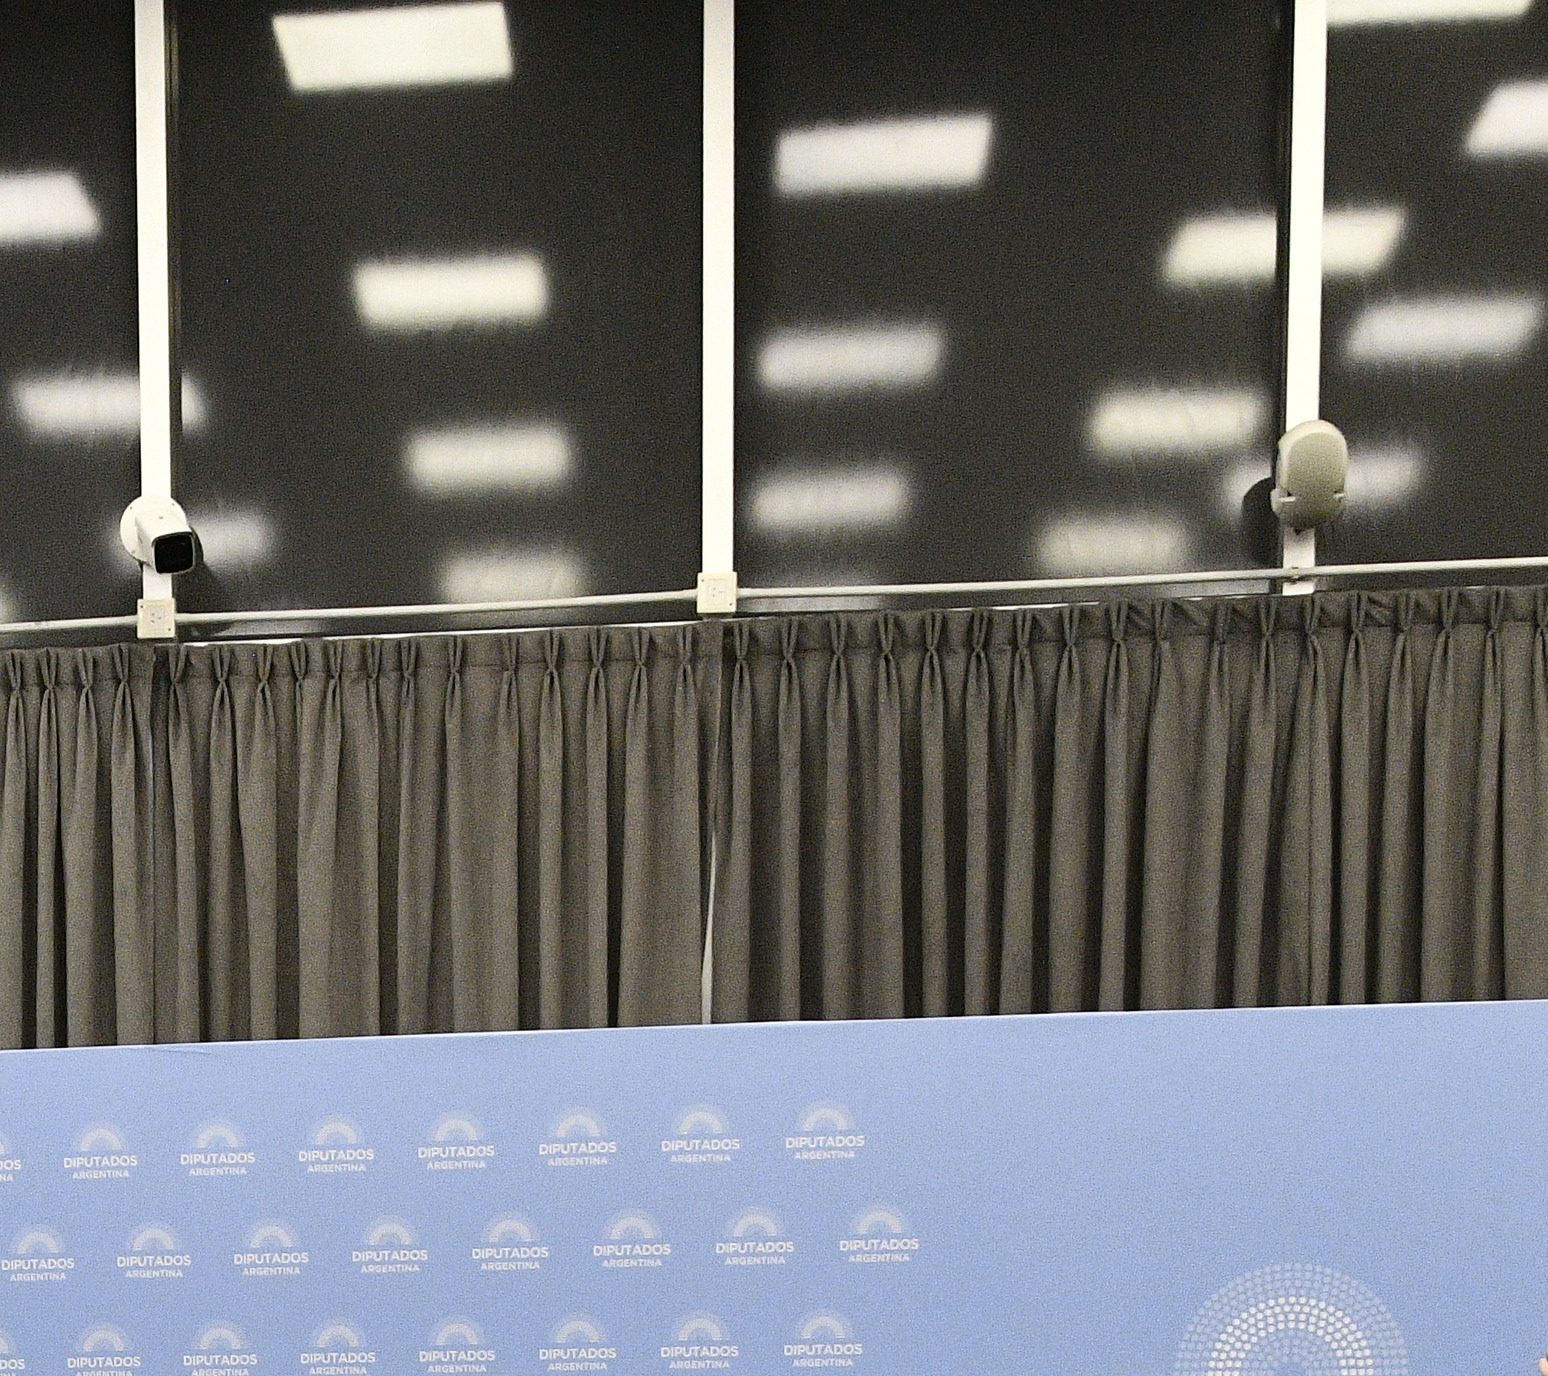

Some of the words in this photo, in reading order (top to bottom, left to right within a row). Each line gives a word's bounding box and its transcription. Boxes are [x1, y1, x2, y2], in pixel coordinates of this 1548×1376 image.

[661, 1139, 740, 1151] DIPUTADOS
[786, 1136, 865, 1148] DIPUTADOS
[418, 1146, 495, 1158] DIPUTADOS
[539, 1142, 617, 1154] DIPUTADOS
[181, 1153, 255, 1164] DIPUTADOS
[298, 1149, 374, 1161] DIPUTADOS
[671, 1154, 731, 1162] ARGENTINA
[795, 1151, 855, 1159] ARGENTINA
[64, 1155, 138, 1167] DIPUTADOS
[427, 1161, 486, 1169] ARGENTINA
[548, 1157, 608, 1165] ARGENTINA
[190, 1167, 246, 1175] ARGENTINA
[308, 1164, 365, 1172] ARGENTINA
[73, 1170, 129, 1178] ARGENTINA
[593, 1244, 671, 1256] DIPUTADOS
[716, 1242, 794, 1253] DIPUTADOS
[840, 1239, 919, 1250] DIPUTADOS
[234, 1253, 309, 1264] DIPUTADOS
[352, 1250, 428, 1261] DIPUTADOS
[472, 1247, 549, 1259] DIPUTADOS
[849, 1254, 910, 1262] ARGENTINA
[1, 1258, 75, 1270] DIPUTADOS
[117, 1255, 191, 1266] DIPUTADOS
[603, 1259, 662, 1267] ARGENTINA
[725, 1256, 785, 1264] ARGENTINA
[243, 1267, 300, 1275] ARGENTINA
[361, 1265, 419, 1273] ARGENTINA
[481, 1262, 540, 1270] ARGENTINA
[11, 1273, 66, 1281] ARGENTINA
[539, 1348, 616, 1359] DIPUTADOS
[660, 1346, 739, 1357] DIPUTADOS
[784, 1344, 863, 1355] DIPUTADOS
[183, 1355, 257, 1365] DIPUTADOS
[300, 1352, 376, 1363] DIPUTADOS
[419, 1350, 495, 1361] DIPUTADOS
[67, 1357, 141, 1368] DIPUTADOS
[670, 1361, 730, 1369] ARGENTINA
[793, 1358, 853, 1367] ARGENTINA
